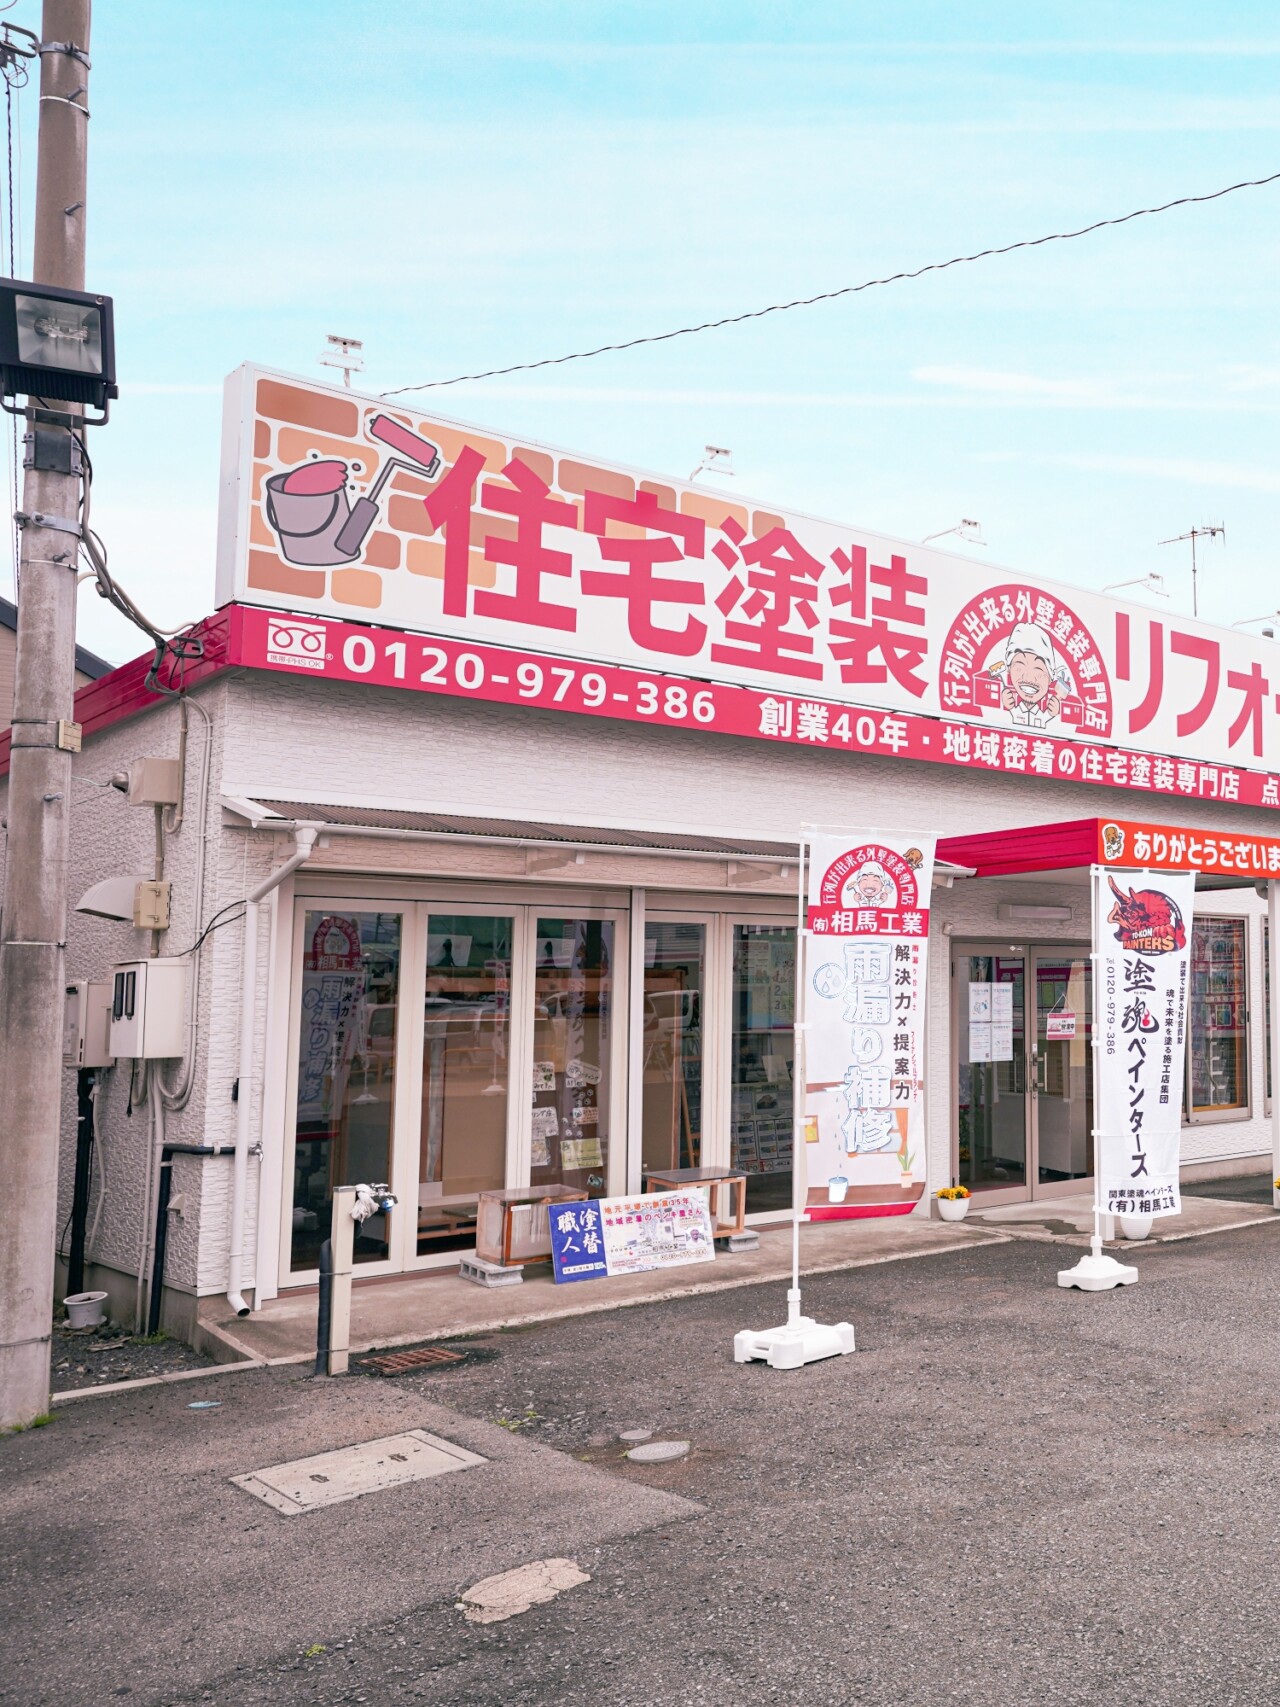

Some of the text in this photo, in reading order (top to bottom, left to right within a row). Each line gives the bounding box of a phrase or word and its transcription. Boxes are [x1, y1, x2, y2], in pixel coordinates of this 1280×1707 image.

[424, 445, 929, 698] 住宅塗装
[341, 633, 716, 725] 0120-979-386
[943, 590, 1109, 732] 行列が出来る外壁塗装専門店
[1123, 935, 1175, 951] PAINTERS
[841, 942, 893, 1155] 雨漏り補修
[893, 943, 912, 1101] 解決力×提案力
